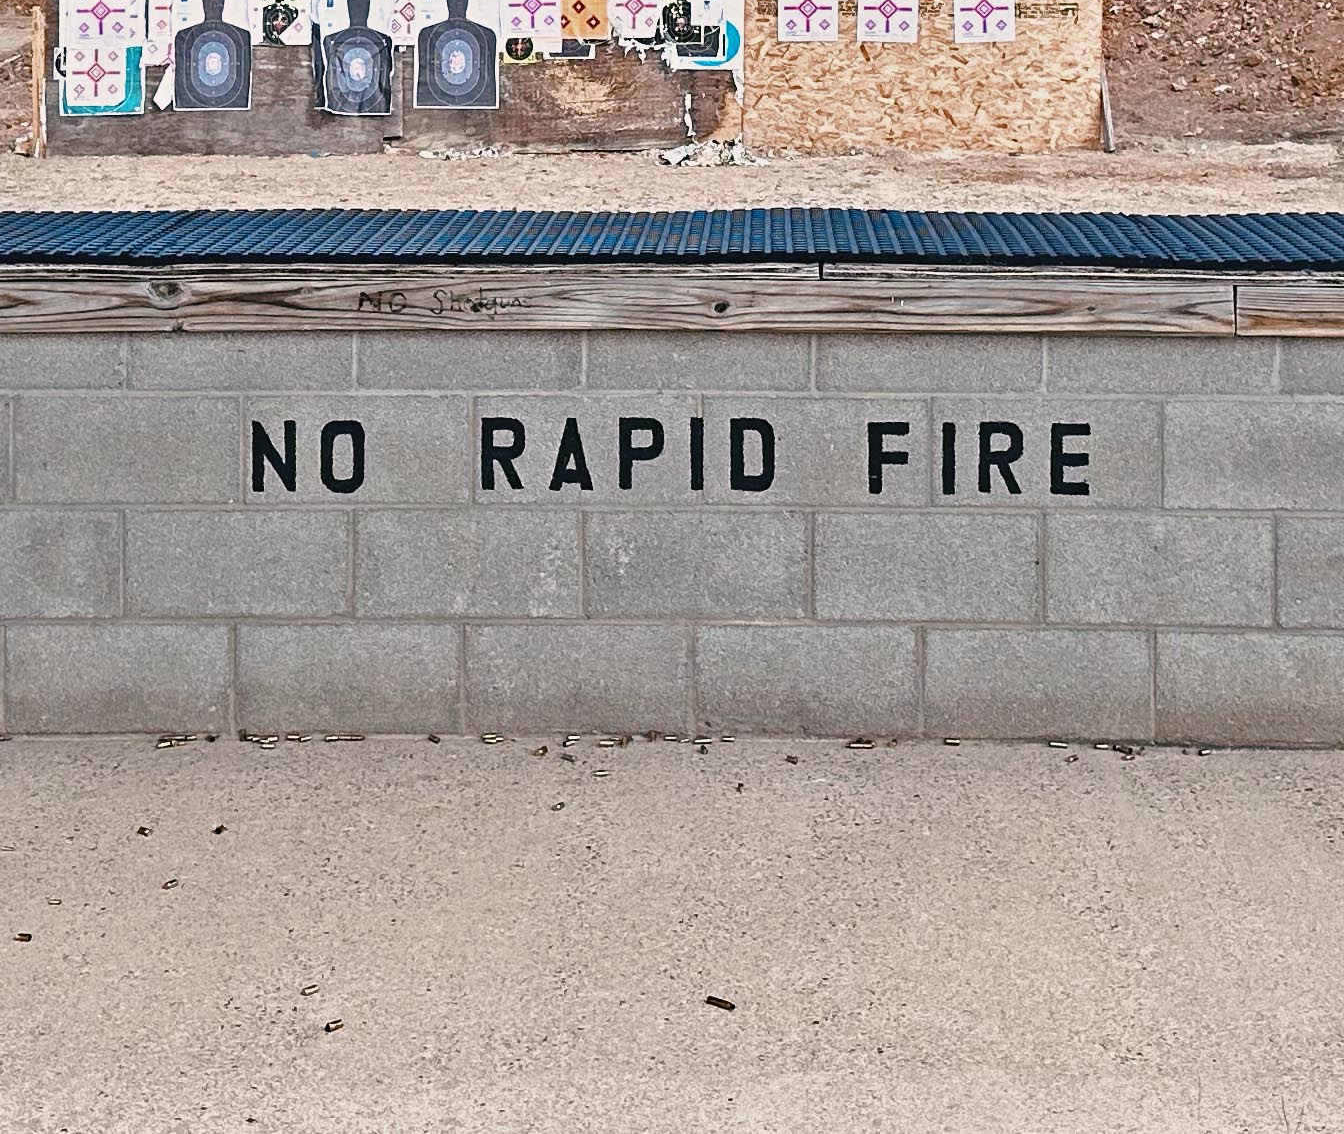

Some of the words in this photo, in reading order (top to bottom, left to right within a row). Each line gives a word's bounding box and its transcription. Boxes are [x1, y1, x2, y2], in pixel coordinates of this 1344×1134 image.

[251, 419, 366, 494] NO
[480, 416, 776, 492] RAPID
[867, 421, 1092, 496] FIRE
